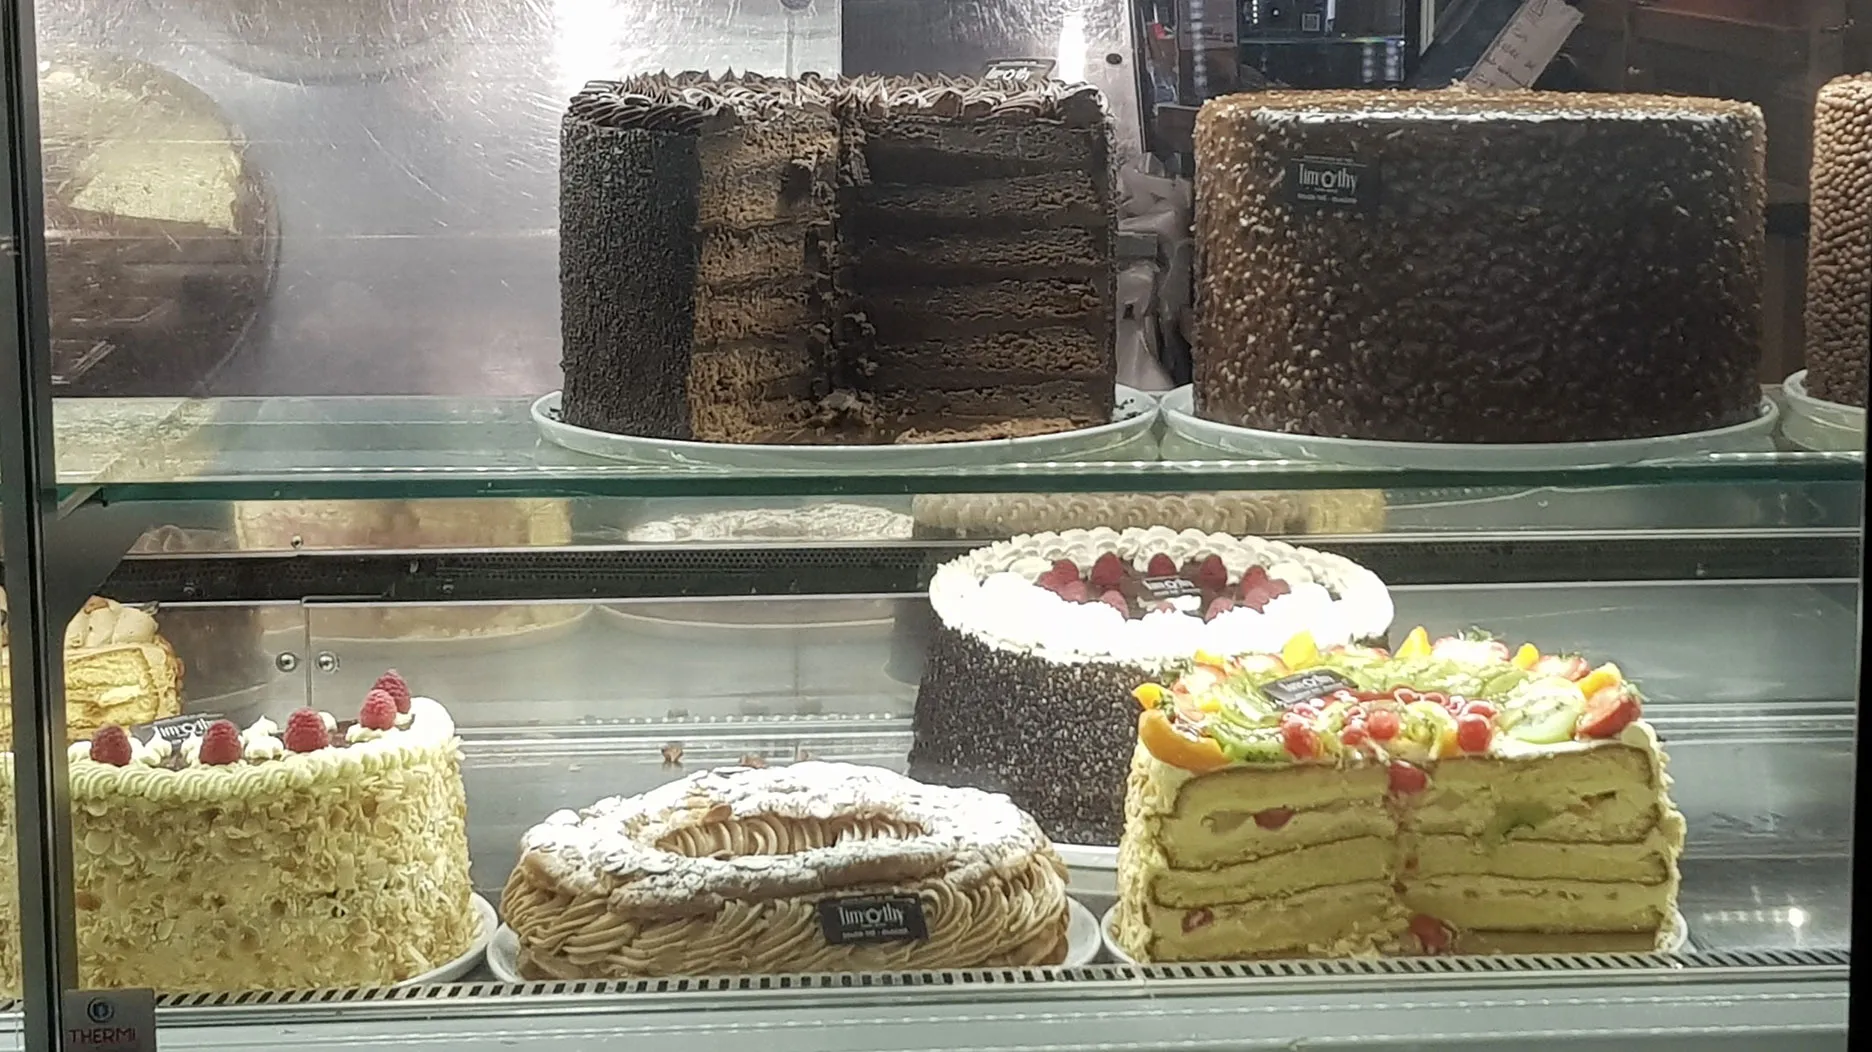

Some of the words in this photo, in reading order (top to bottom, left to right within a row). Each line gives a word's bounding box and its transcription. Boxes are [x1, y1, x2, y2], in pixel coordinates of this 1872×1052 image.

[1299, 163, 1358, 196] Timothy
[152, 718, 208, 738] Timoth
[839, 902, 904, 926] Timothy
[69, 1027, 136, 1044] THERMI
